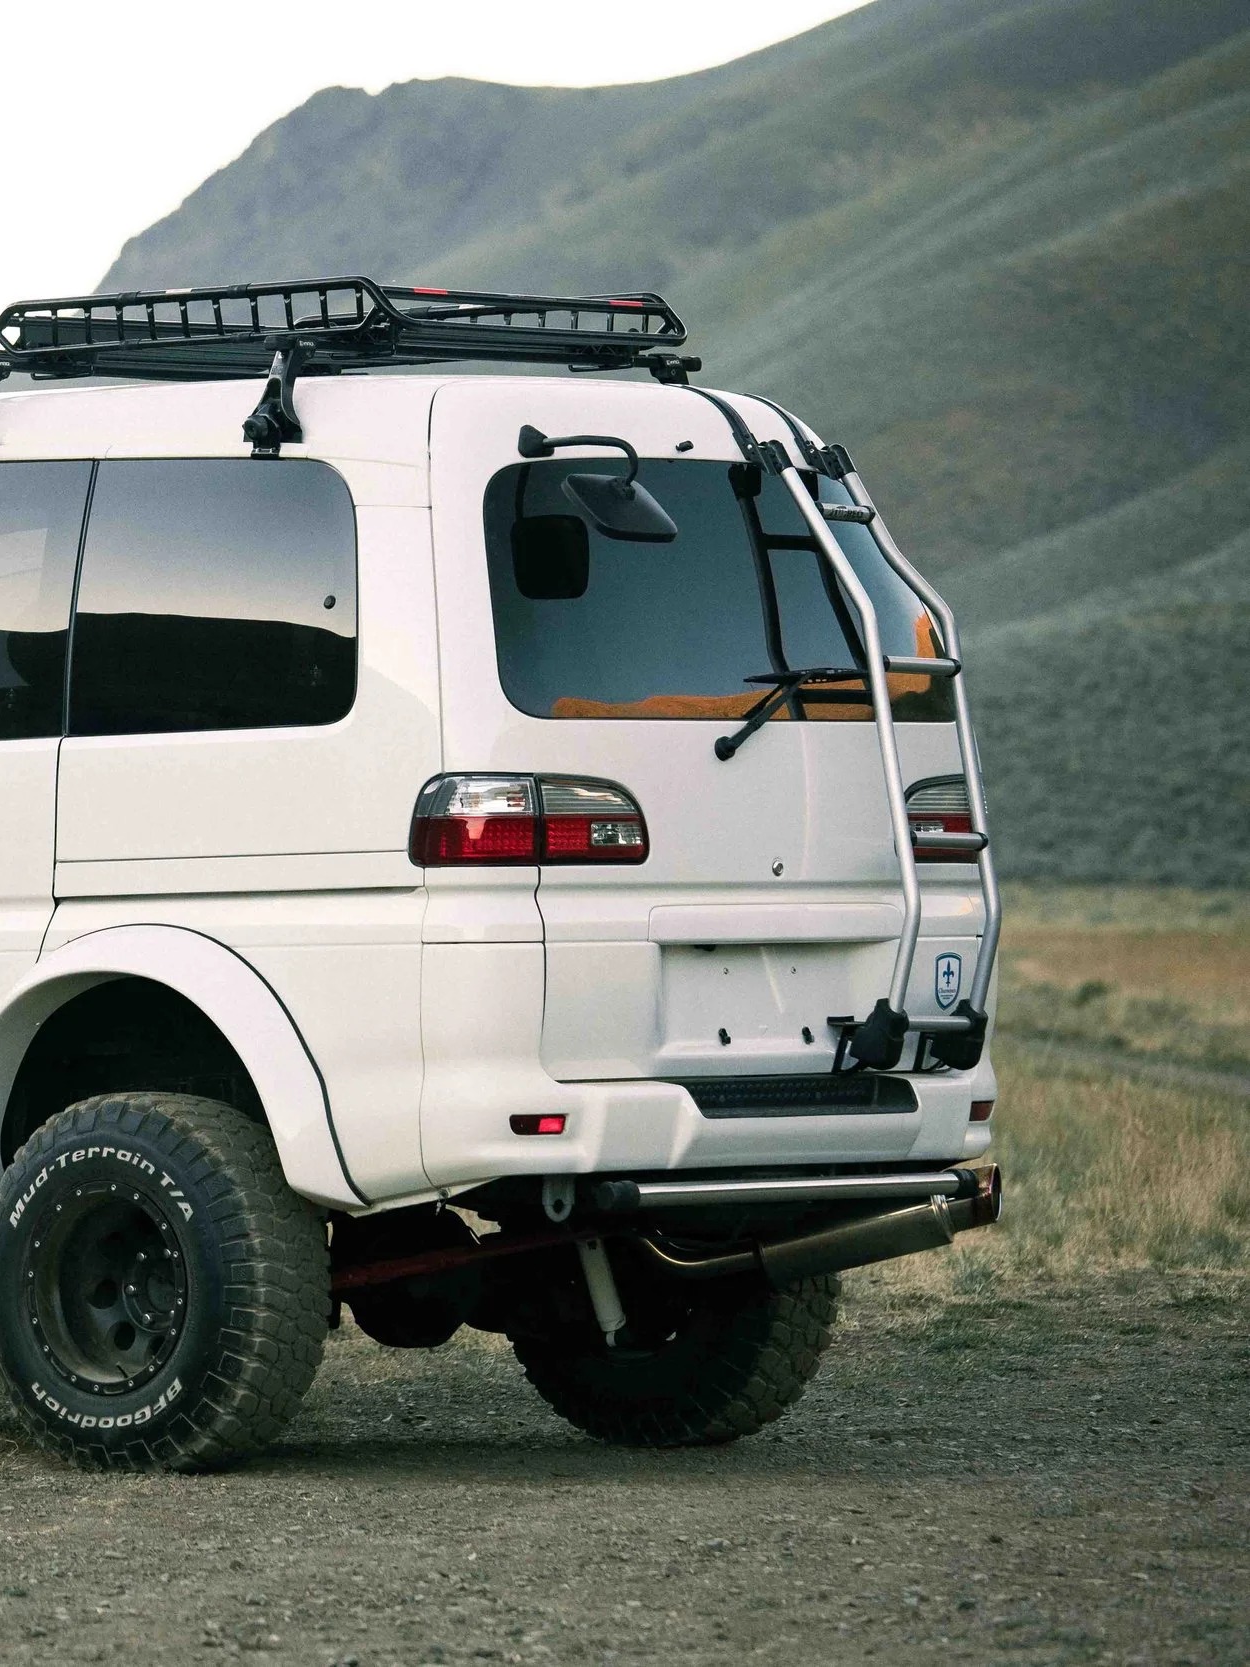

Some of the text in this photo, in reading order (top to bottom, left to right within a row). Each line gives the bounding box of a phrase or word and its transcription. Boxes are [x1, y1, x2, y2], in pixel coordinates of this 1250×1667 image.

[8, 1146, 195, 1229] Mud-Terrain T/A
[30, 1375, 183, 1430] BFGoodrich
